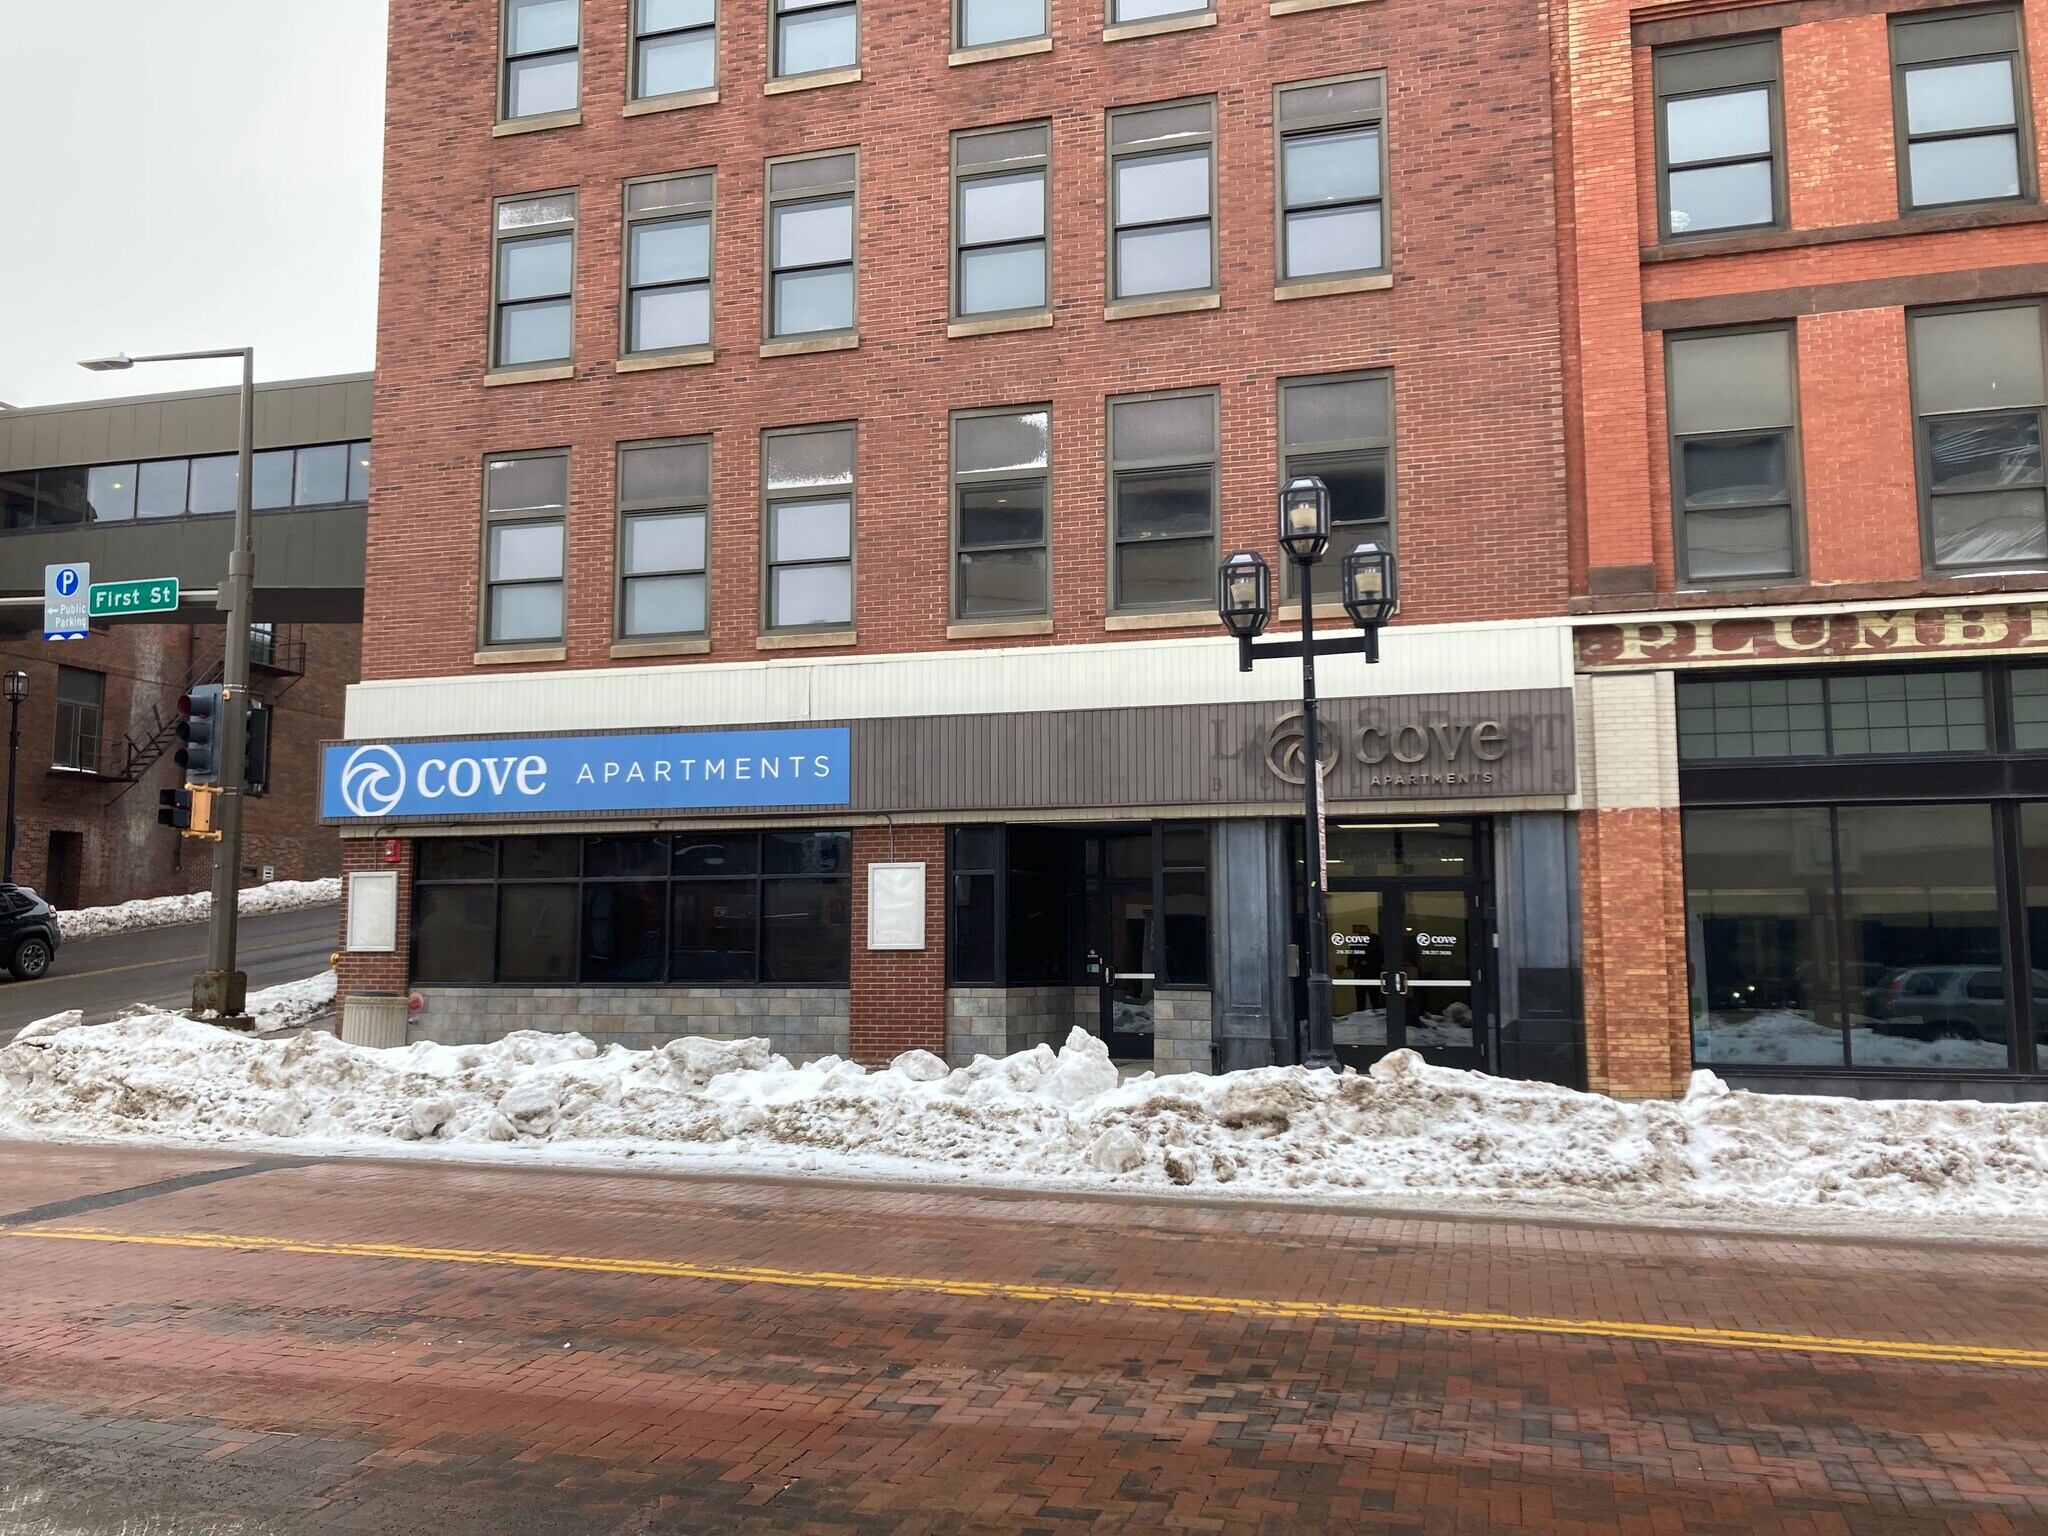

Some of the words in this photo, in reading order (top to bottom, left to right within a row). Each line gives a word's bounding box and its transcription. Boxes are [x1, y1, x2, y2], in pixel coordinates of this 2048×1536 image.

[63, 571, 74, 594] P
[96, 589, 140, 608] First
[150, 586, 170, 603] St
[60, 604, 86, 614] Public
[55, 616, 87, 630] Parking
[1354, 720, 1507, 764] cove
[417, 754, 547, 798] cove
[576, 755, 831, 785] APARTMENTS
[1370, 772, 1493, 787] APARTMENTS
[1345, 935, 1371, 943] cove
[1431, 935, 1457, 944] cove
